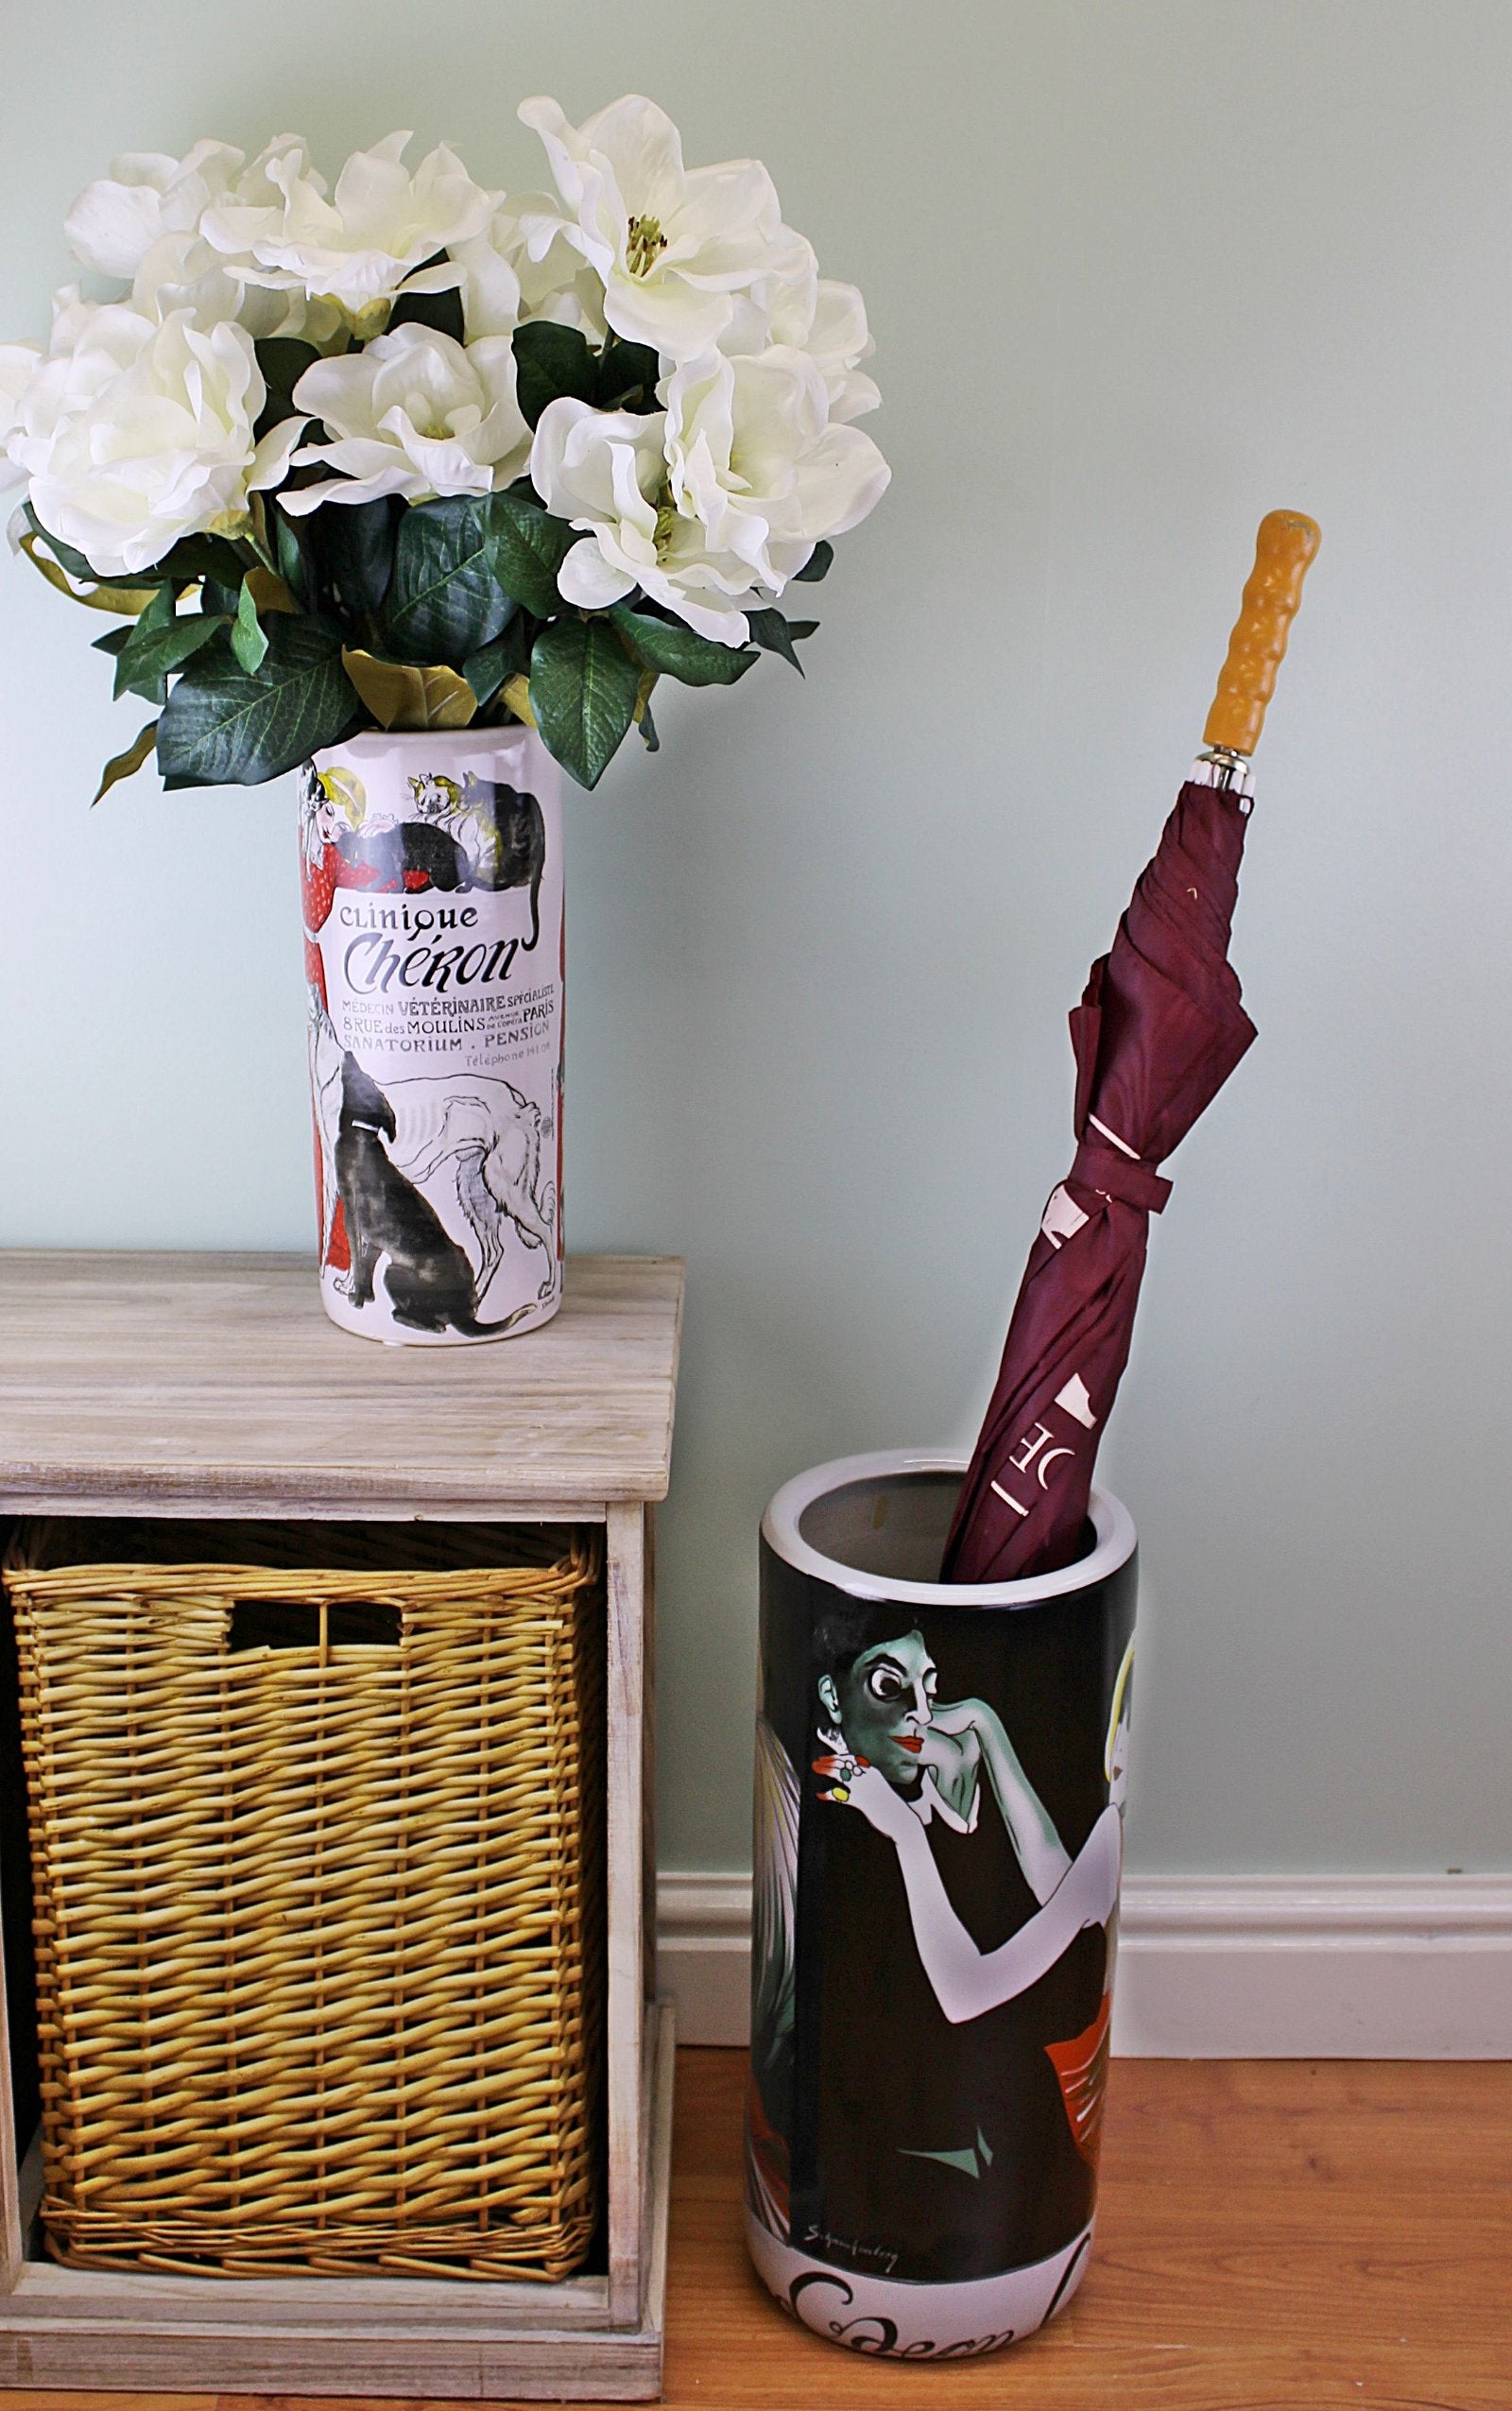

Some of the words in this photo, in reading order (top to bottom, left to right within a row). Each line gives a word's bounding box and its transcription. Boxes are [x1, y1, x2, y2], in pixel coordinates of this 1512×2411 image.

[342, 998, 395, 1016] MÉDECIN
[398, 995, 506, 1016] VÉTÉRINAIRE
[507, 983, 555, 1008] SPÉCIALISTE
[523, 998, 555, 1023] PARIS
[343, 1016, 352, 1031] 8
[354, 1017, 383, 1034] RUE
[385, 1022, 405, 1035] des
[407, 1016, 486, 1035] MOULINS
[488, 1010, 519, 1022] AVENUE
[344, 1034, 463, 1053] SANATORIUM
[484, 1020, 550, 1048] PENSION
[464, 1050, 524, 1067] Téléphone
